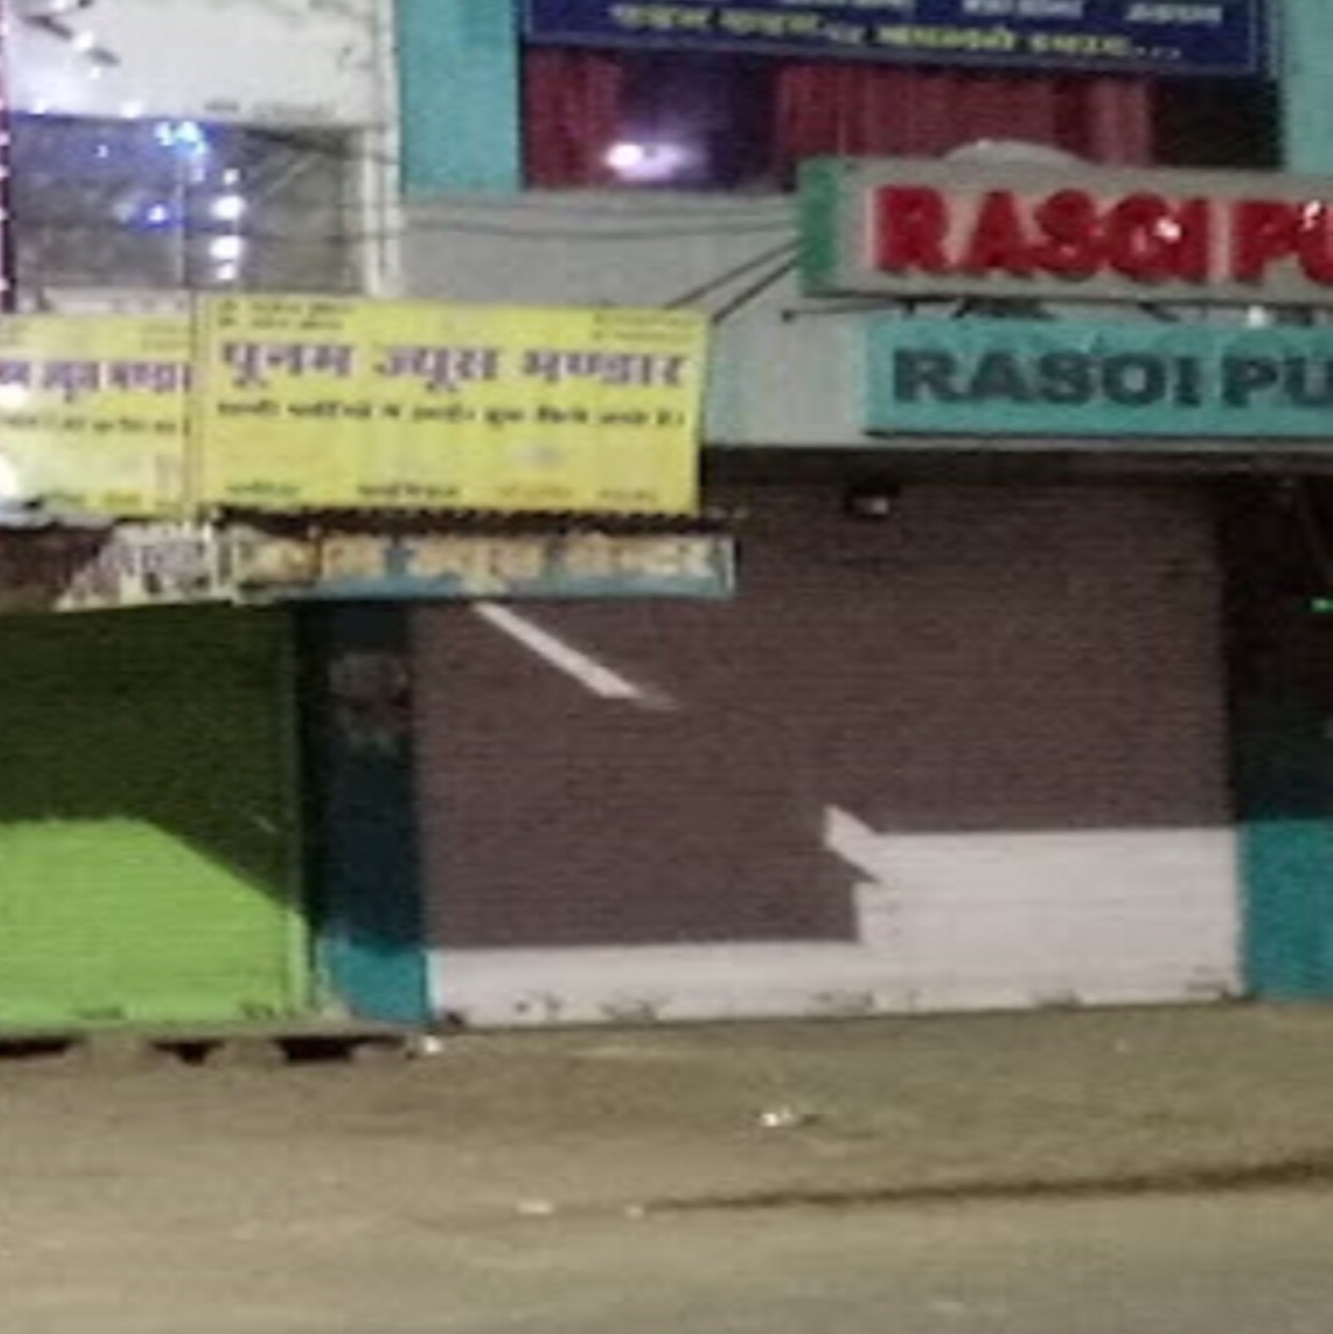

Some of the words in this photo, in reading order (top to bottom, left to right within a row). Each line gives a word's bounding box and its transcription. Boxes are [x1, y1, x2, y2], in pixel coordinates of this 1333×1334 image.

[876, 184, 1211, 283] RASOI
[221, 341, 351, 391] पूनम
[375, 343, 501, 393] ज्यूस
[523, 349, 687, 387] भण्डार
[893, 349, 1201, 407] RASOI
[1222, 354, 1333, 409] PU
